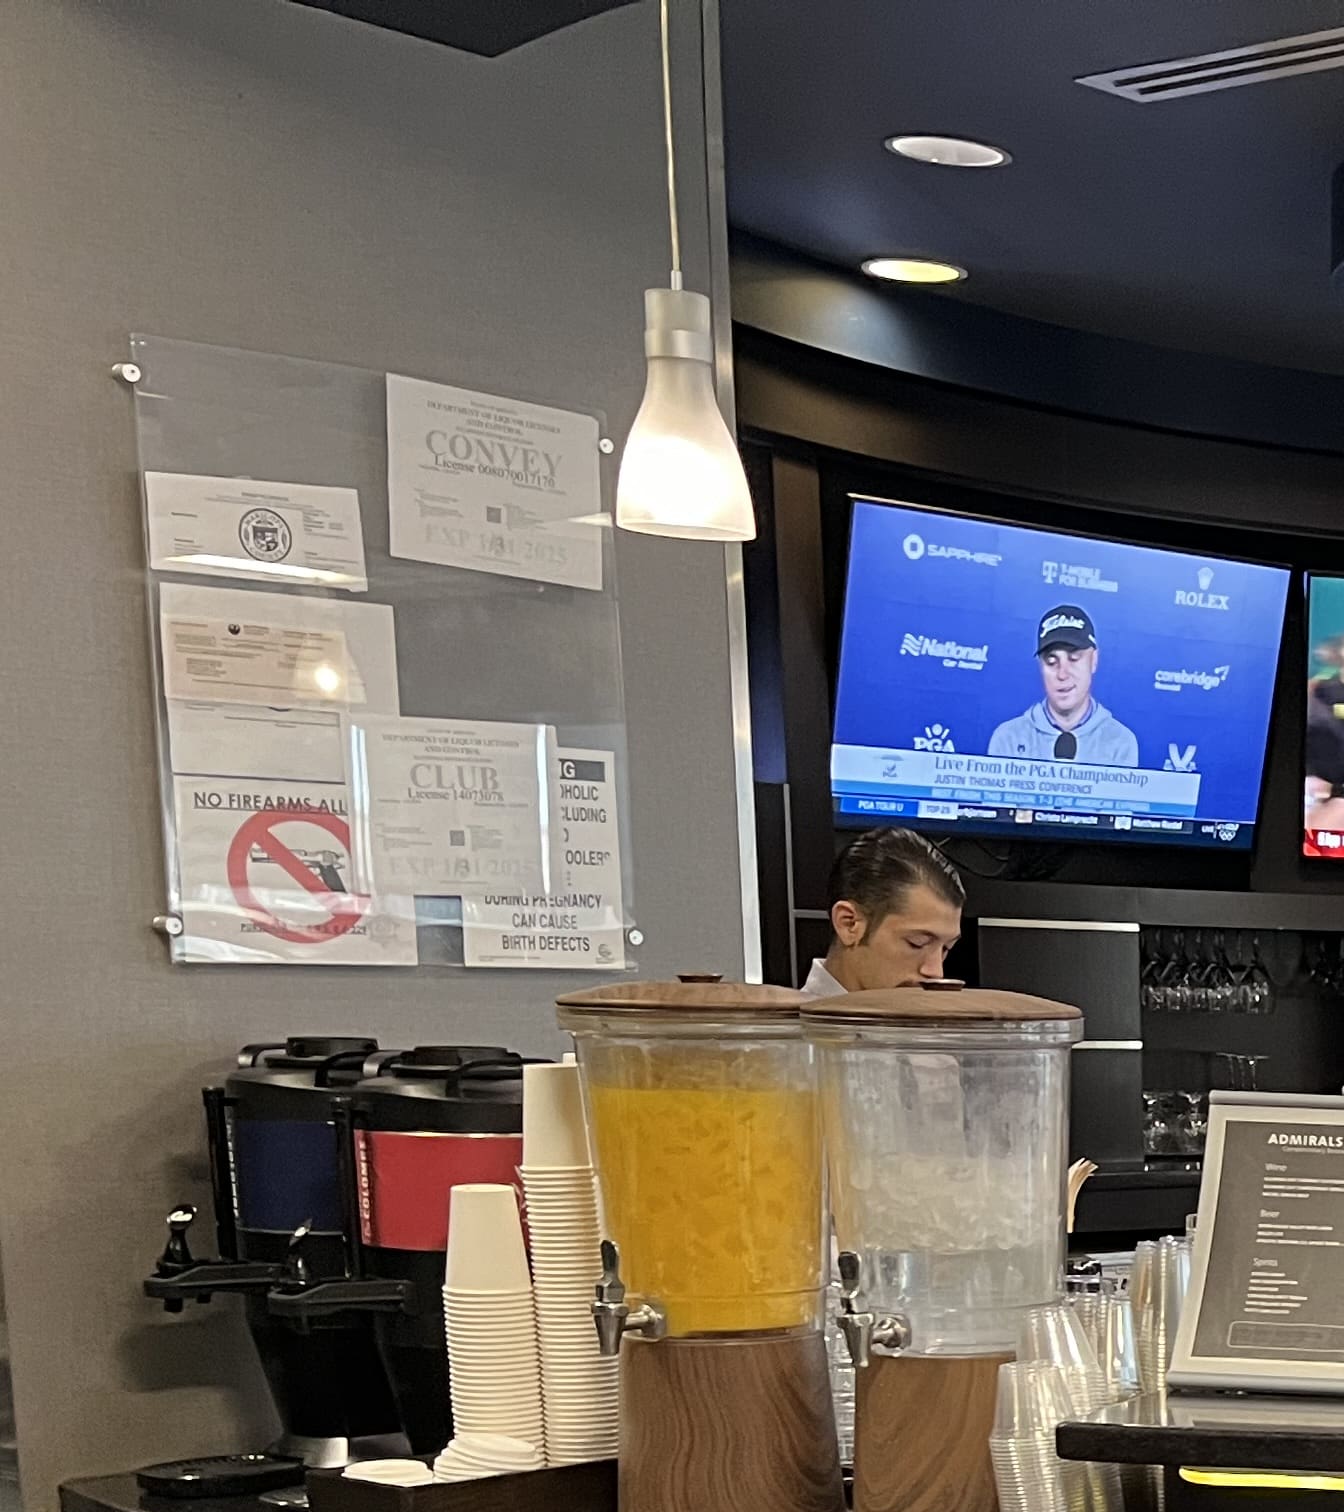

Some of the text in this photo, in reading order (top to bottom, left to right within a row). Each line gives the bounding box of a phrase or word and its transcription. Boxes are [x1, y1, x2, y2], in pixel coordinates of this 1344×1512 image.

[426, 430, 563, 478] CONVEY
[434, 455, 476, 474] License
[1175, 590, 1230, 610] ROLEX
[921, 637, 988, 662] National
[913, 737, 955, 753] PGA
[410, 763, 499, 791] CLUB
[935, 756, 1149, 788] Live From the PGA Championship
[407, 787, 450, 801] License
[934, 774, 1092, 795] JUSTIN THOMAS PRESS CONFERENCE
[194, 792, 347, 814] NO FIREARMS ALL
[512, 913, 578, 930] CAN CAUSE
[502, 935, 591, 951] BIRTH DEFECTS
[1267, 1134, 1344, 1147] ADMIRALS
